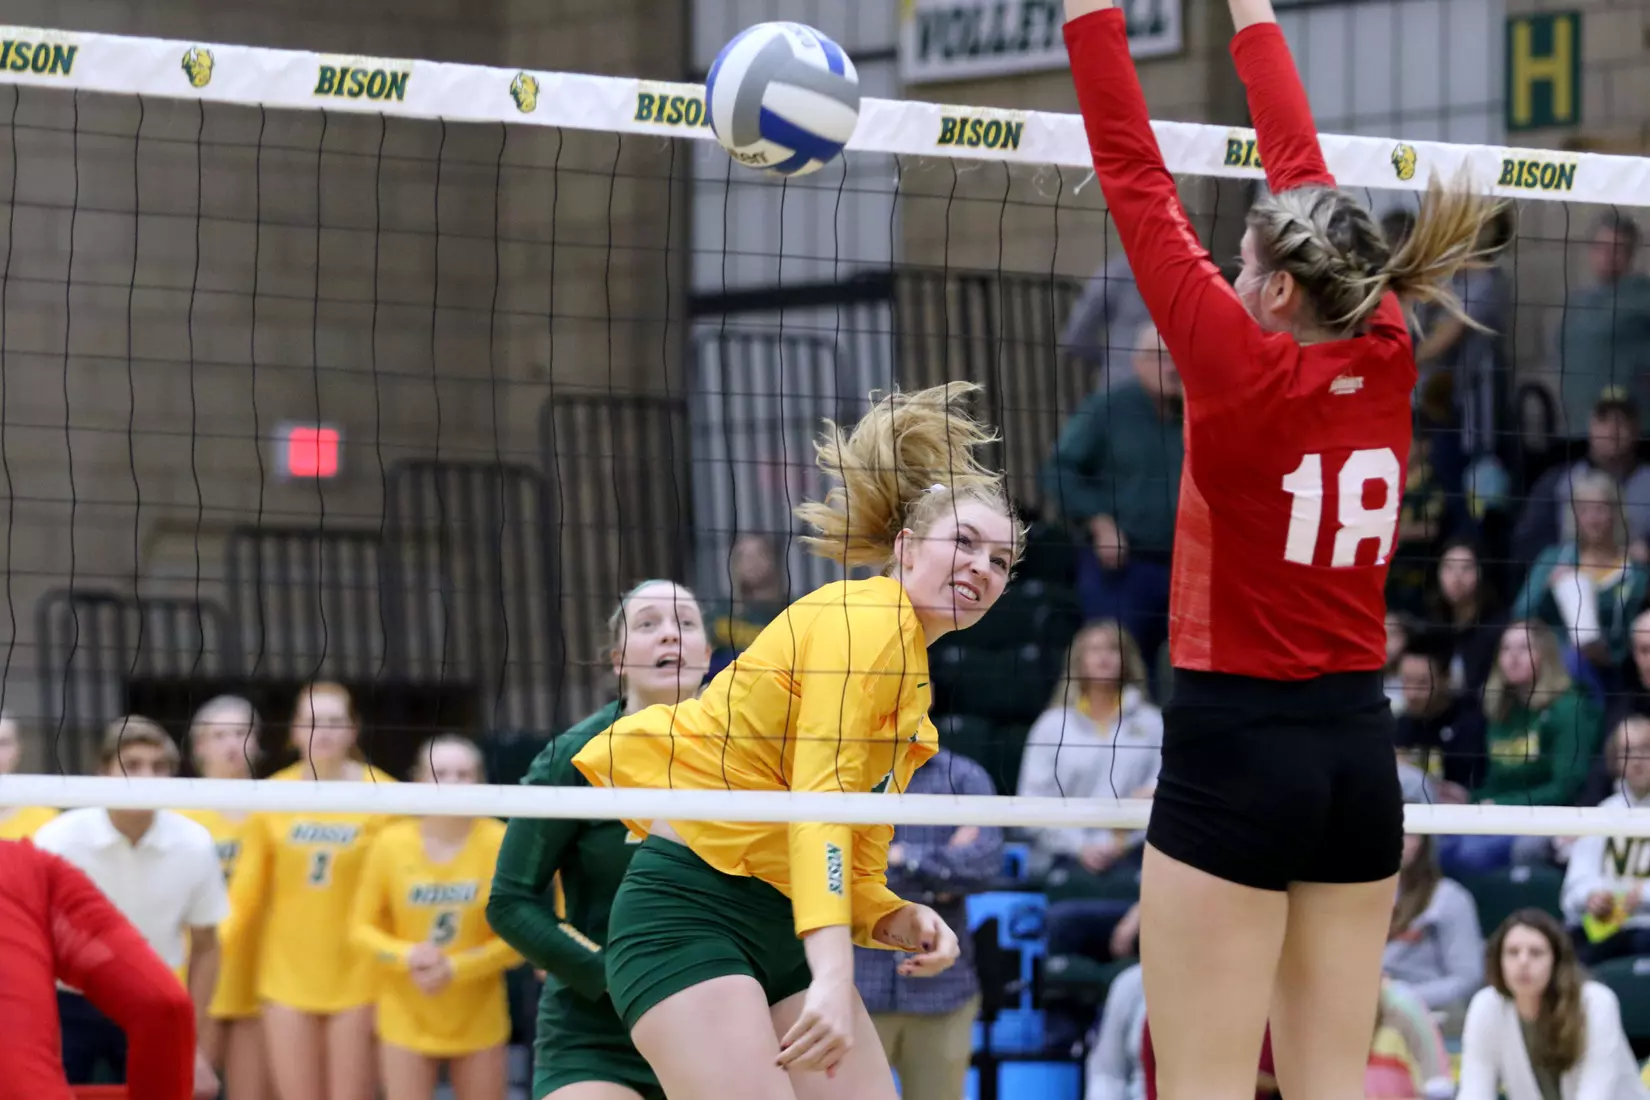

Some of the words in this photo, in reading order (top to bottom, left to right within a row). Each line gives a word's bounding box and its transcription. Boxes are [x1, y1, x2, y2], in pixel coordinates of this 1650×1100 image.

[0, 39, 79, 75] ISON
[1511, 16, 1574, 126] H
[313, 64, 411, 102] BISON
[937, 116, 1024, 151] BISON
[1498, 159, 1577, 191] BISON
[1281, 447, 1400, 568] 18
